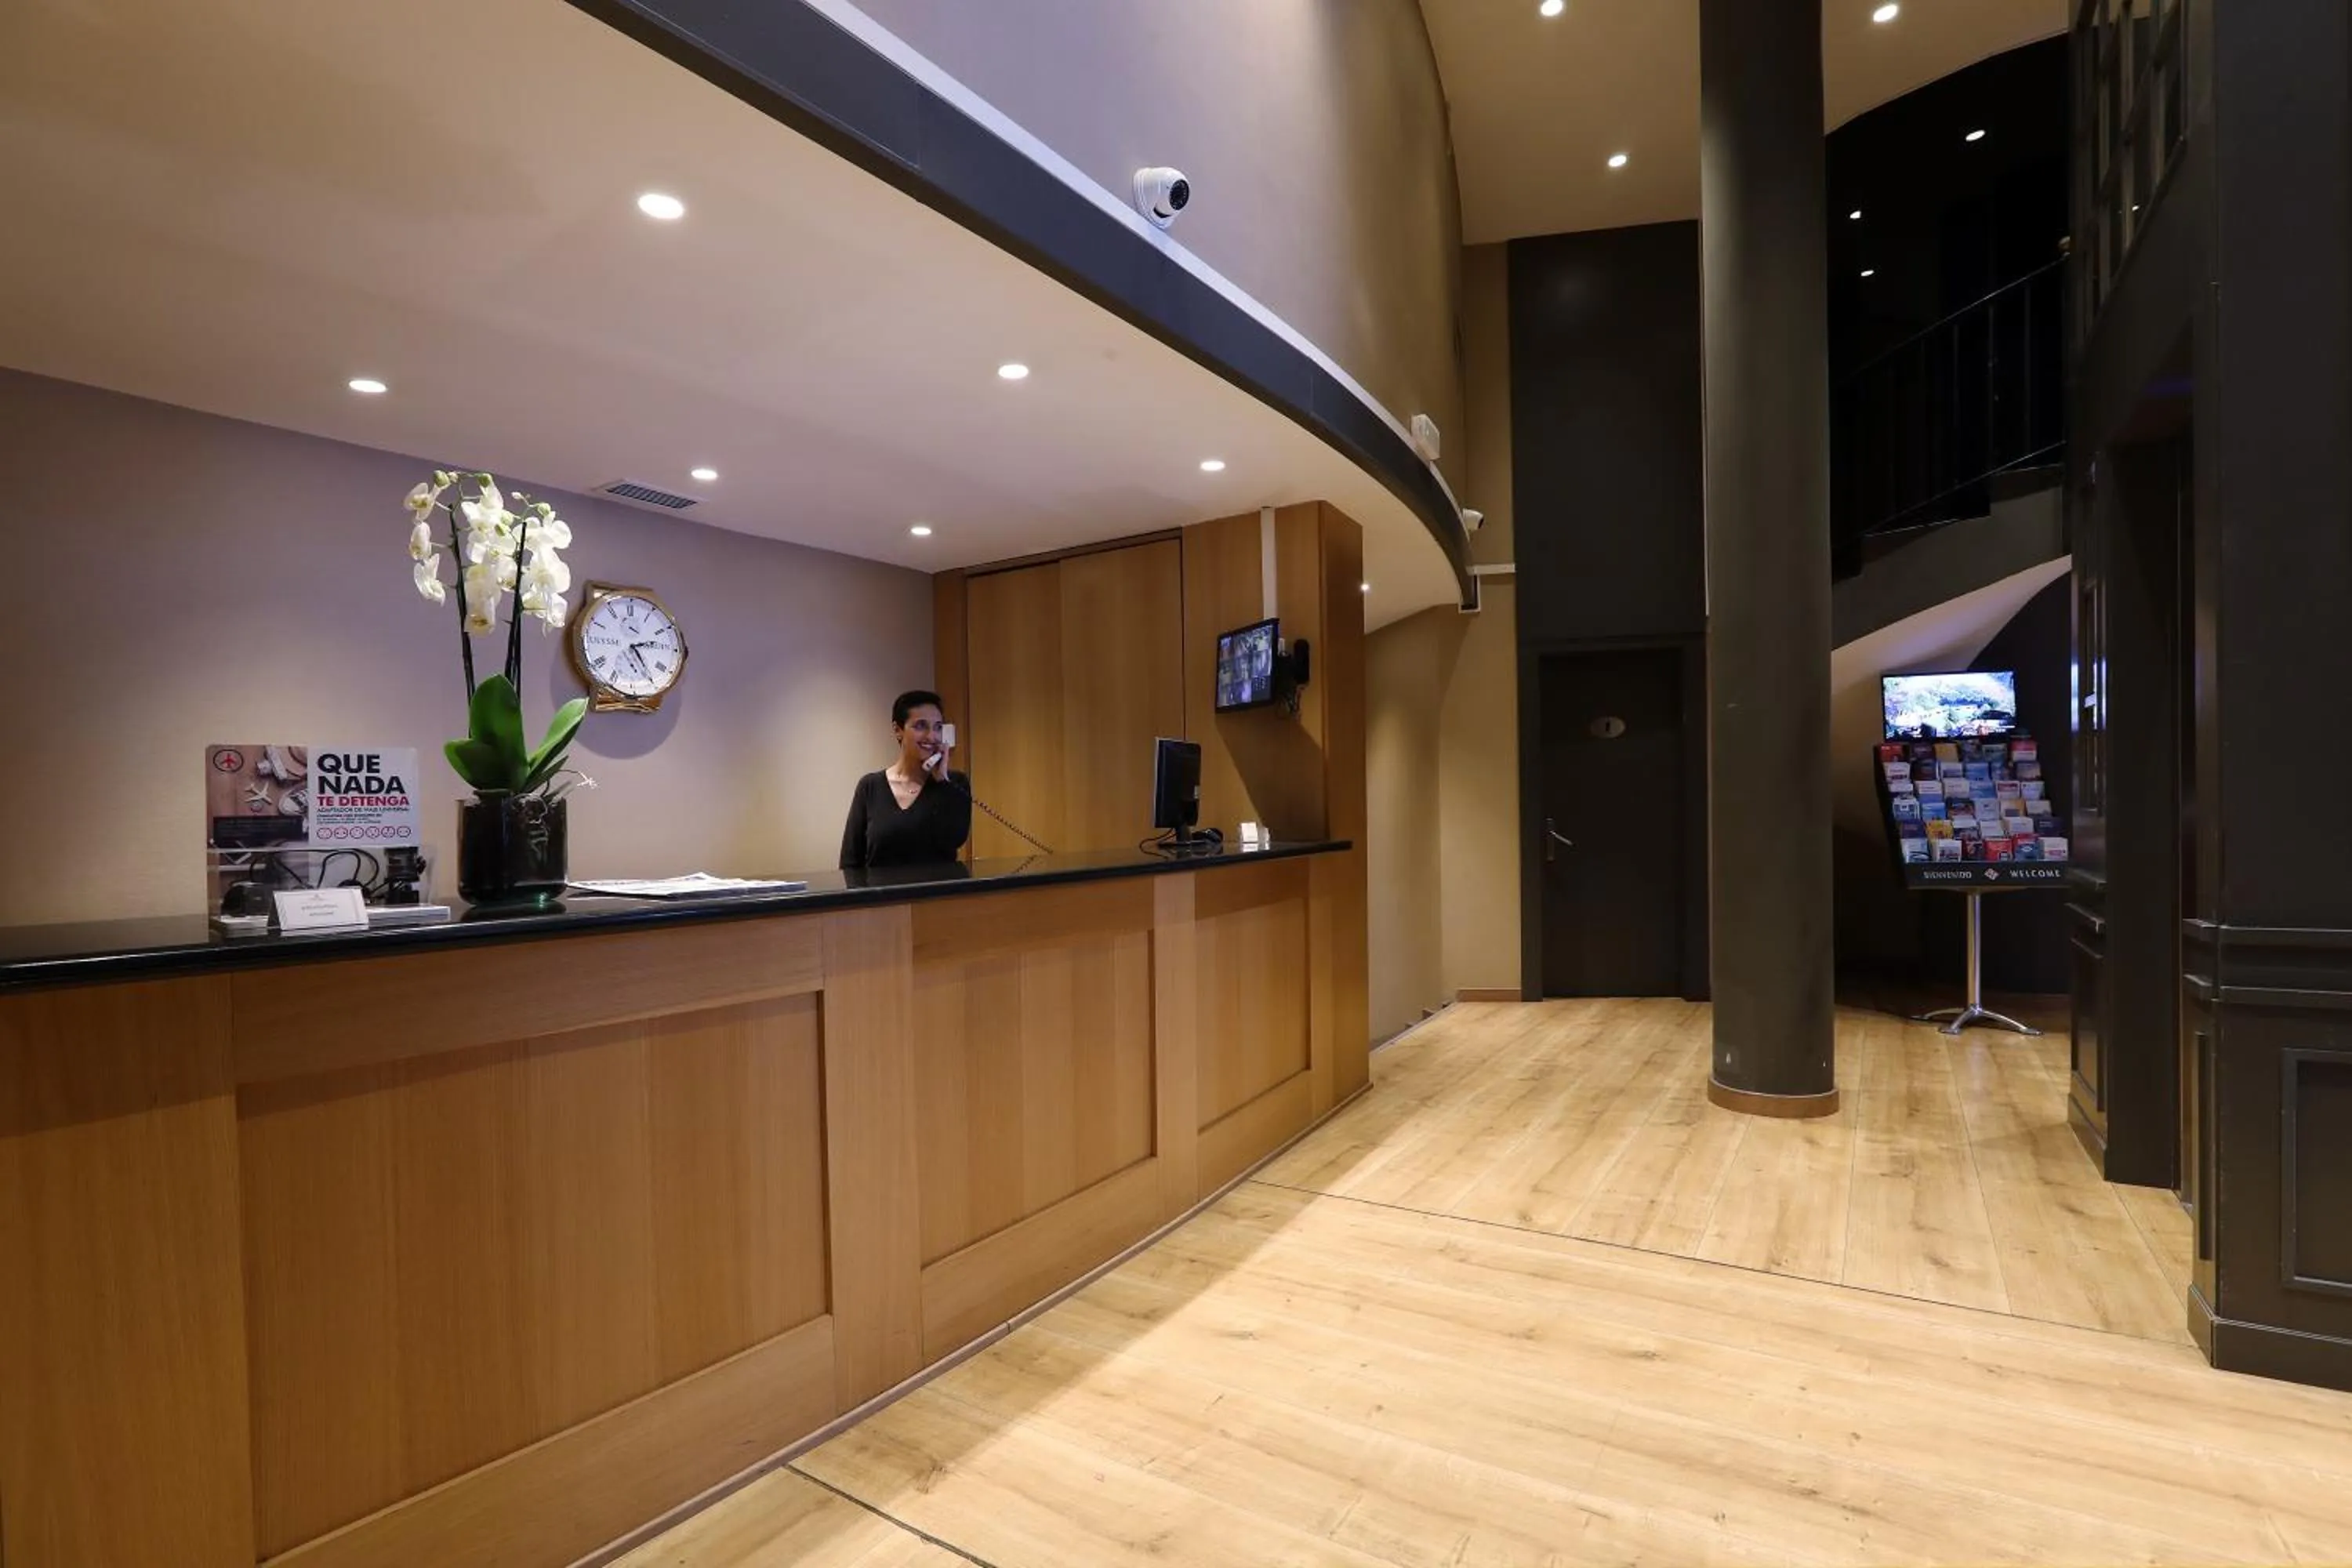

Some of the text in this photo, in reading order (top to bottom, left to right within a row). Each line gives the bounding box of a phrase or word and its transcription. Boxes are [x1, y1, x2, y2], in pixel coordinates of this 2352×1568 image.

[318, 753, 380, 774] QUE
[318, 776, 405, 794] NADA
[317, 796, 409, 806] TE DETENGA
[2009, 869, 2061, 878] WELCOME
